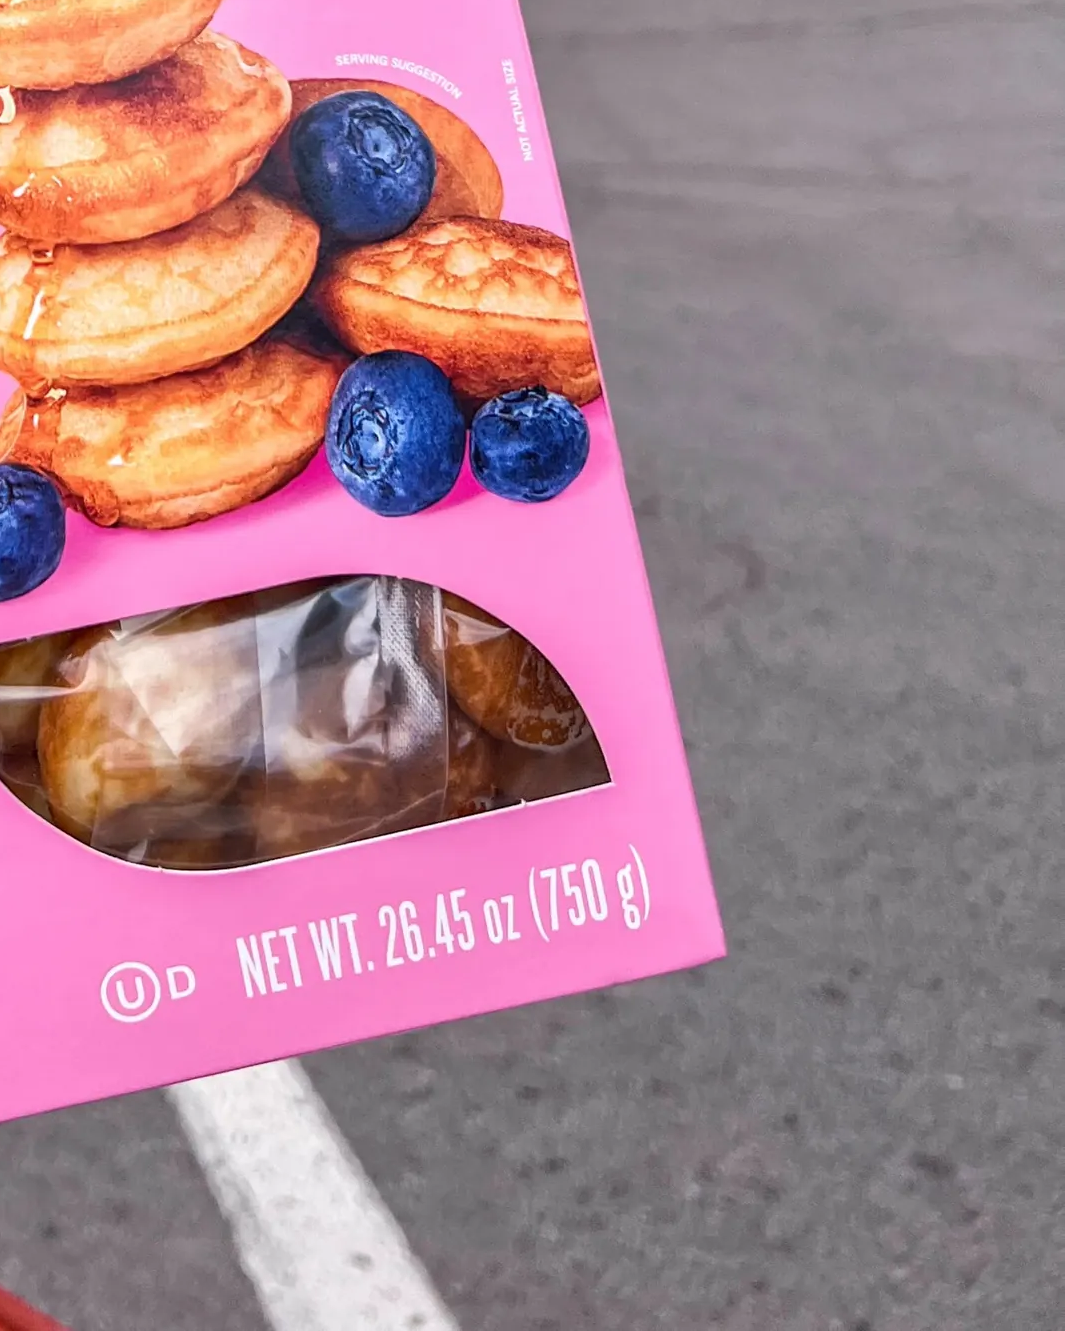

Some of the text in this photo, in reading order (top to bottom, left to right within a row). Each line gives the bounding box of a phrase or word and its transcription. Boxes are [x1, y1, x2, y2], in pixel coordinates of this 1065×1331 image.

[335, 53, 463, 100] SERVING SUGGESTION
[501, 58, 534, 162] NOT ACTUAL SIZE
[236, 843, 651, 997] NET WT. 26.45 oz (750 g)
